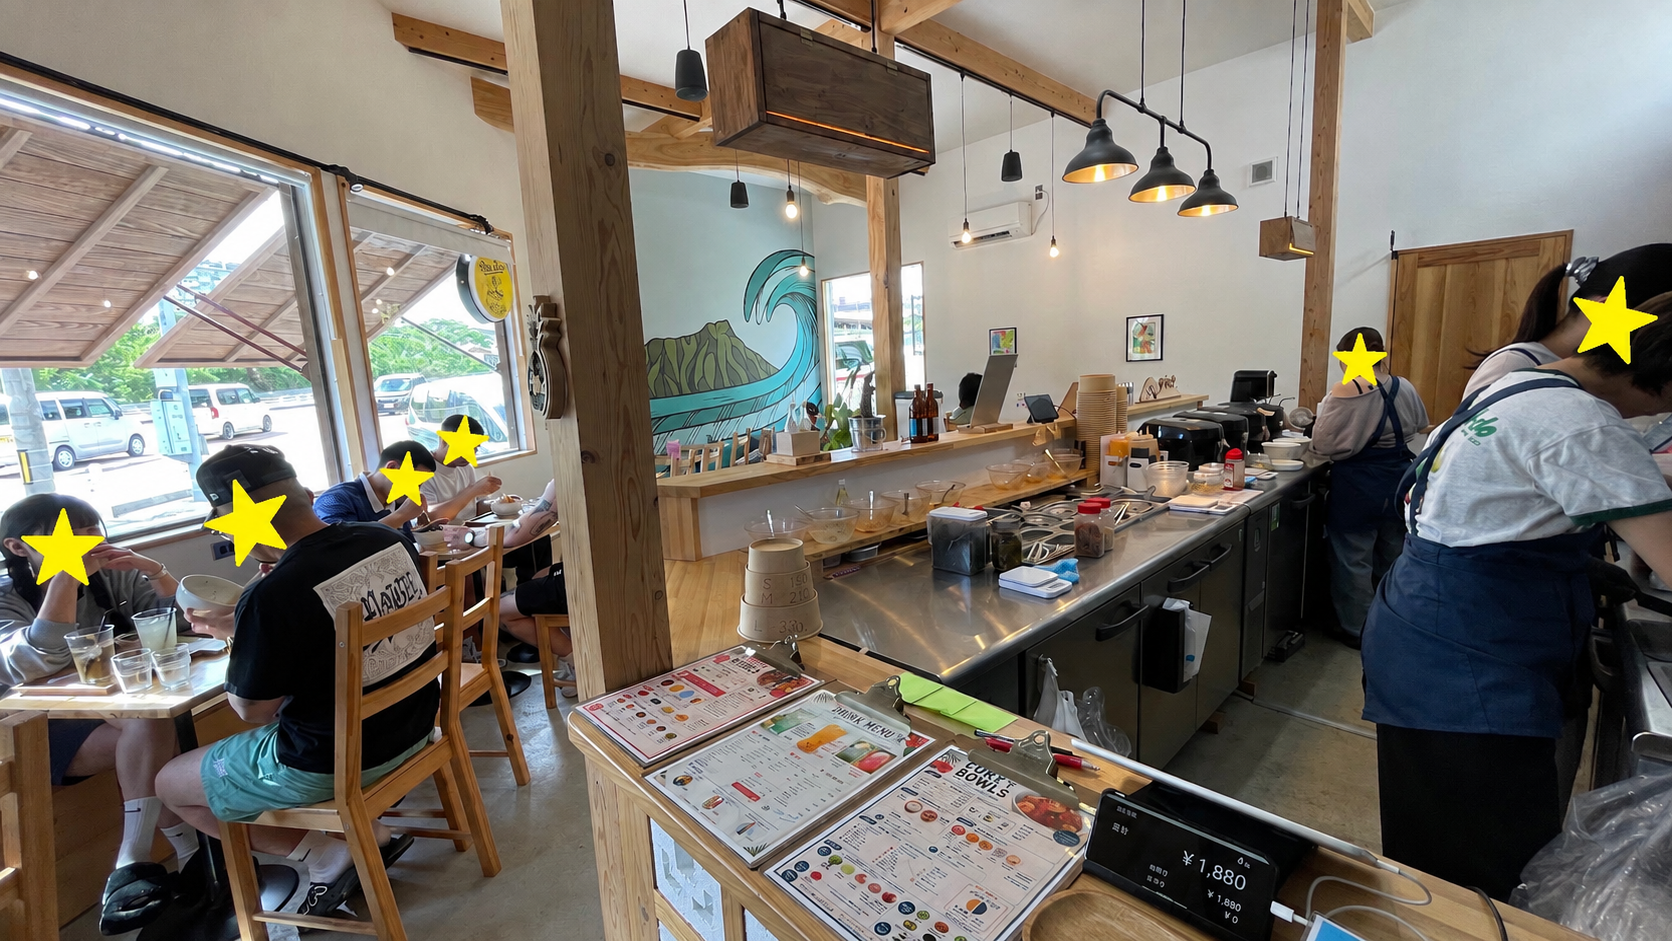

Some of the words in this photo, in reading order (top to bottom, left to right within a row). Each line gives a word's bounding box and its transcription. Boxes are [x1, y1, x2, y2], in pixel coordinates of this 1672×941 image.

[762, 578, 772, 590] S
[761, 593, 773, 605] M
[754, 620, 763, 632] L
[863, 721, 896, 738] MENU
[953, 767, 1011, 799] BOWLS
